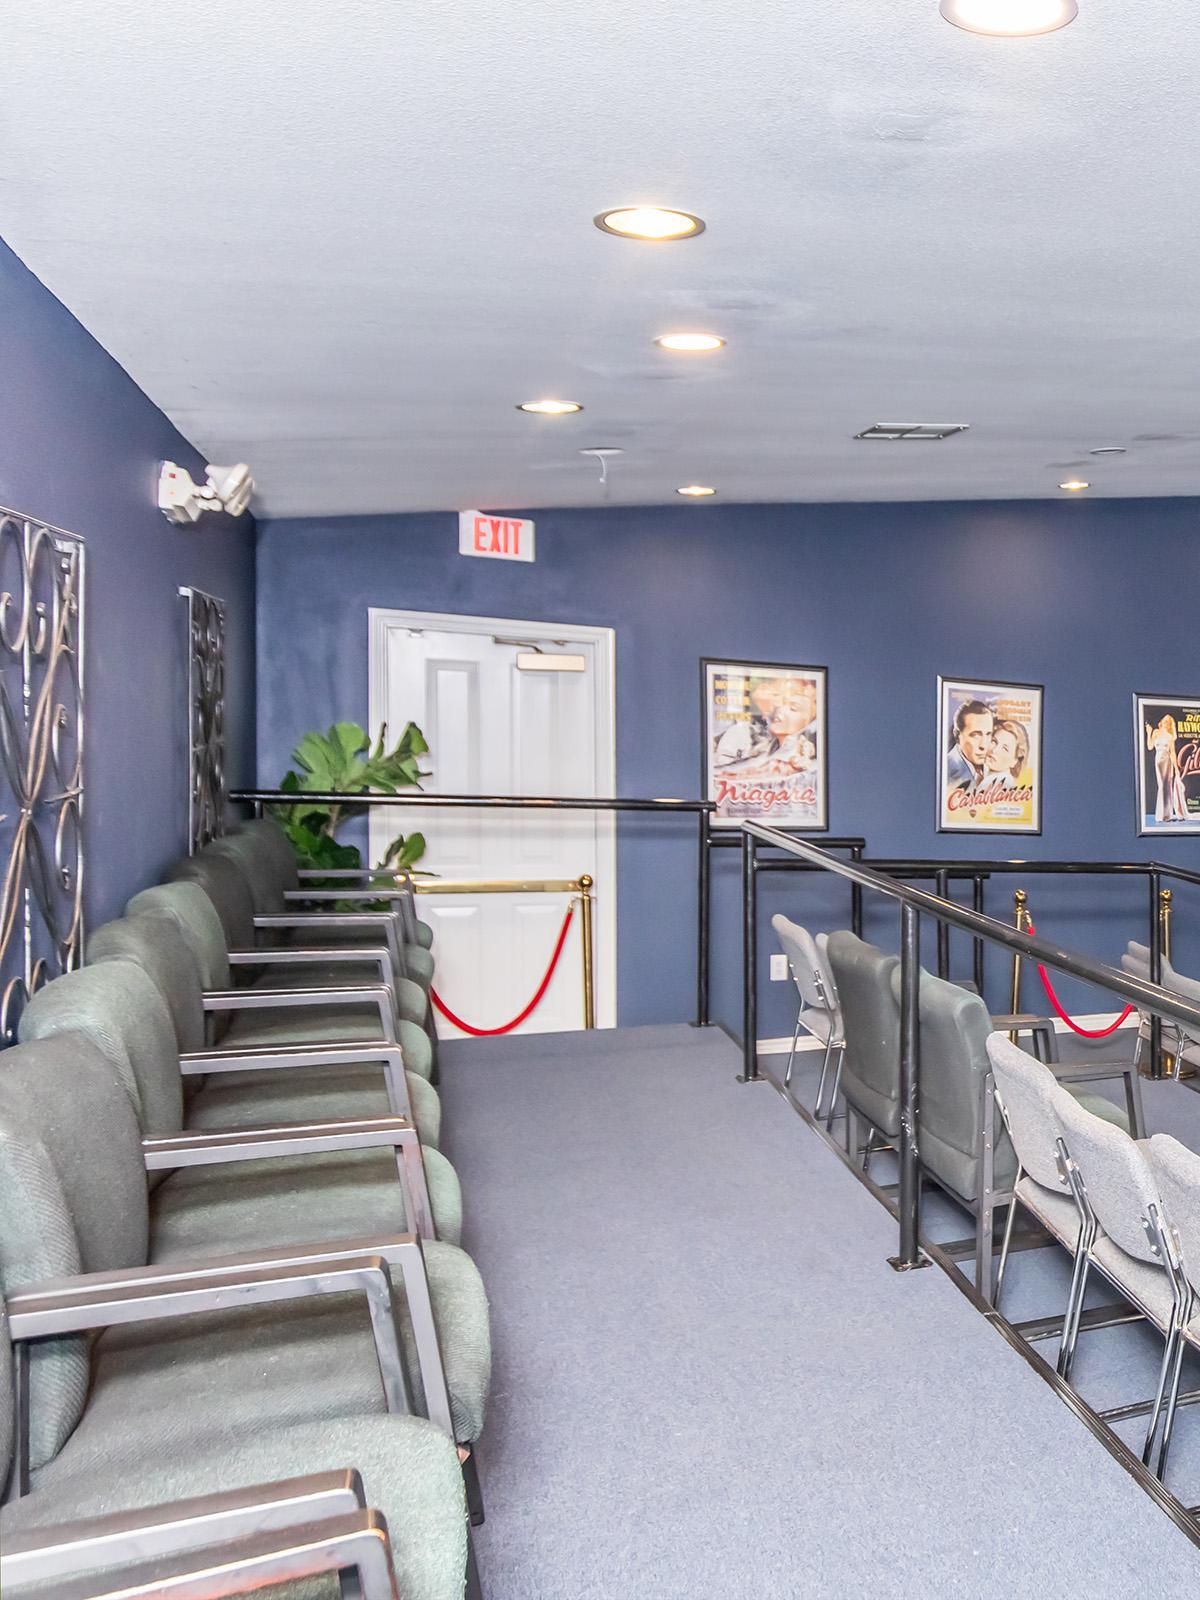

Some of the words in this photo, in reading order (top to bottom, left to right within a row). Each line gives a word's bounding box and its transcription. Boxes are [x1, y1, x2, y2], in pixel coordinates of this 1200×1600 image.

[474, 517, 523, 555] EXIT
[717, 781, 816, 811] Niagara
[947, 781, 1032, 812] Casablanca
